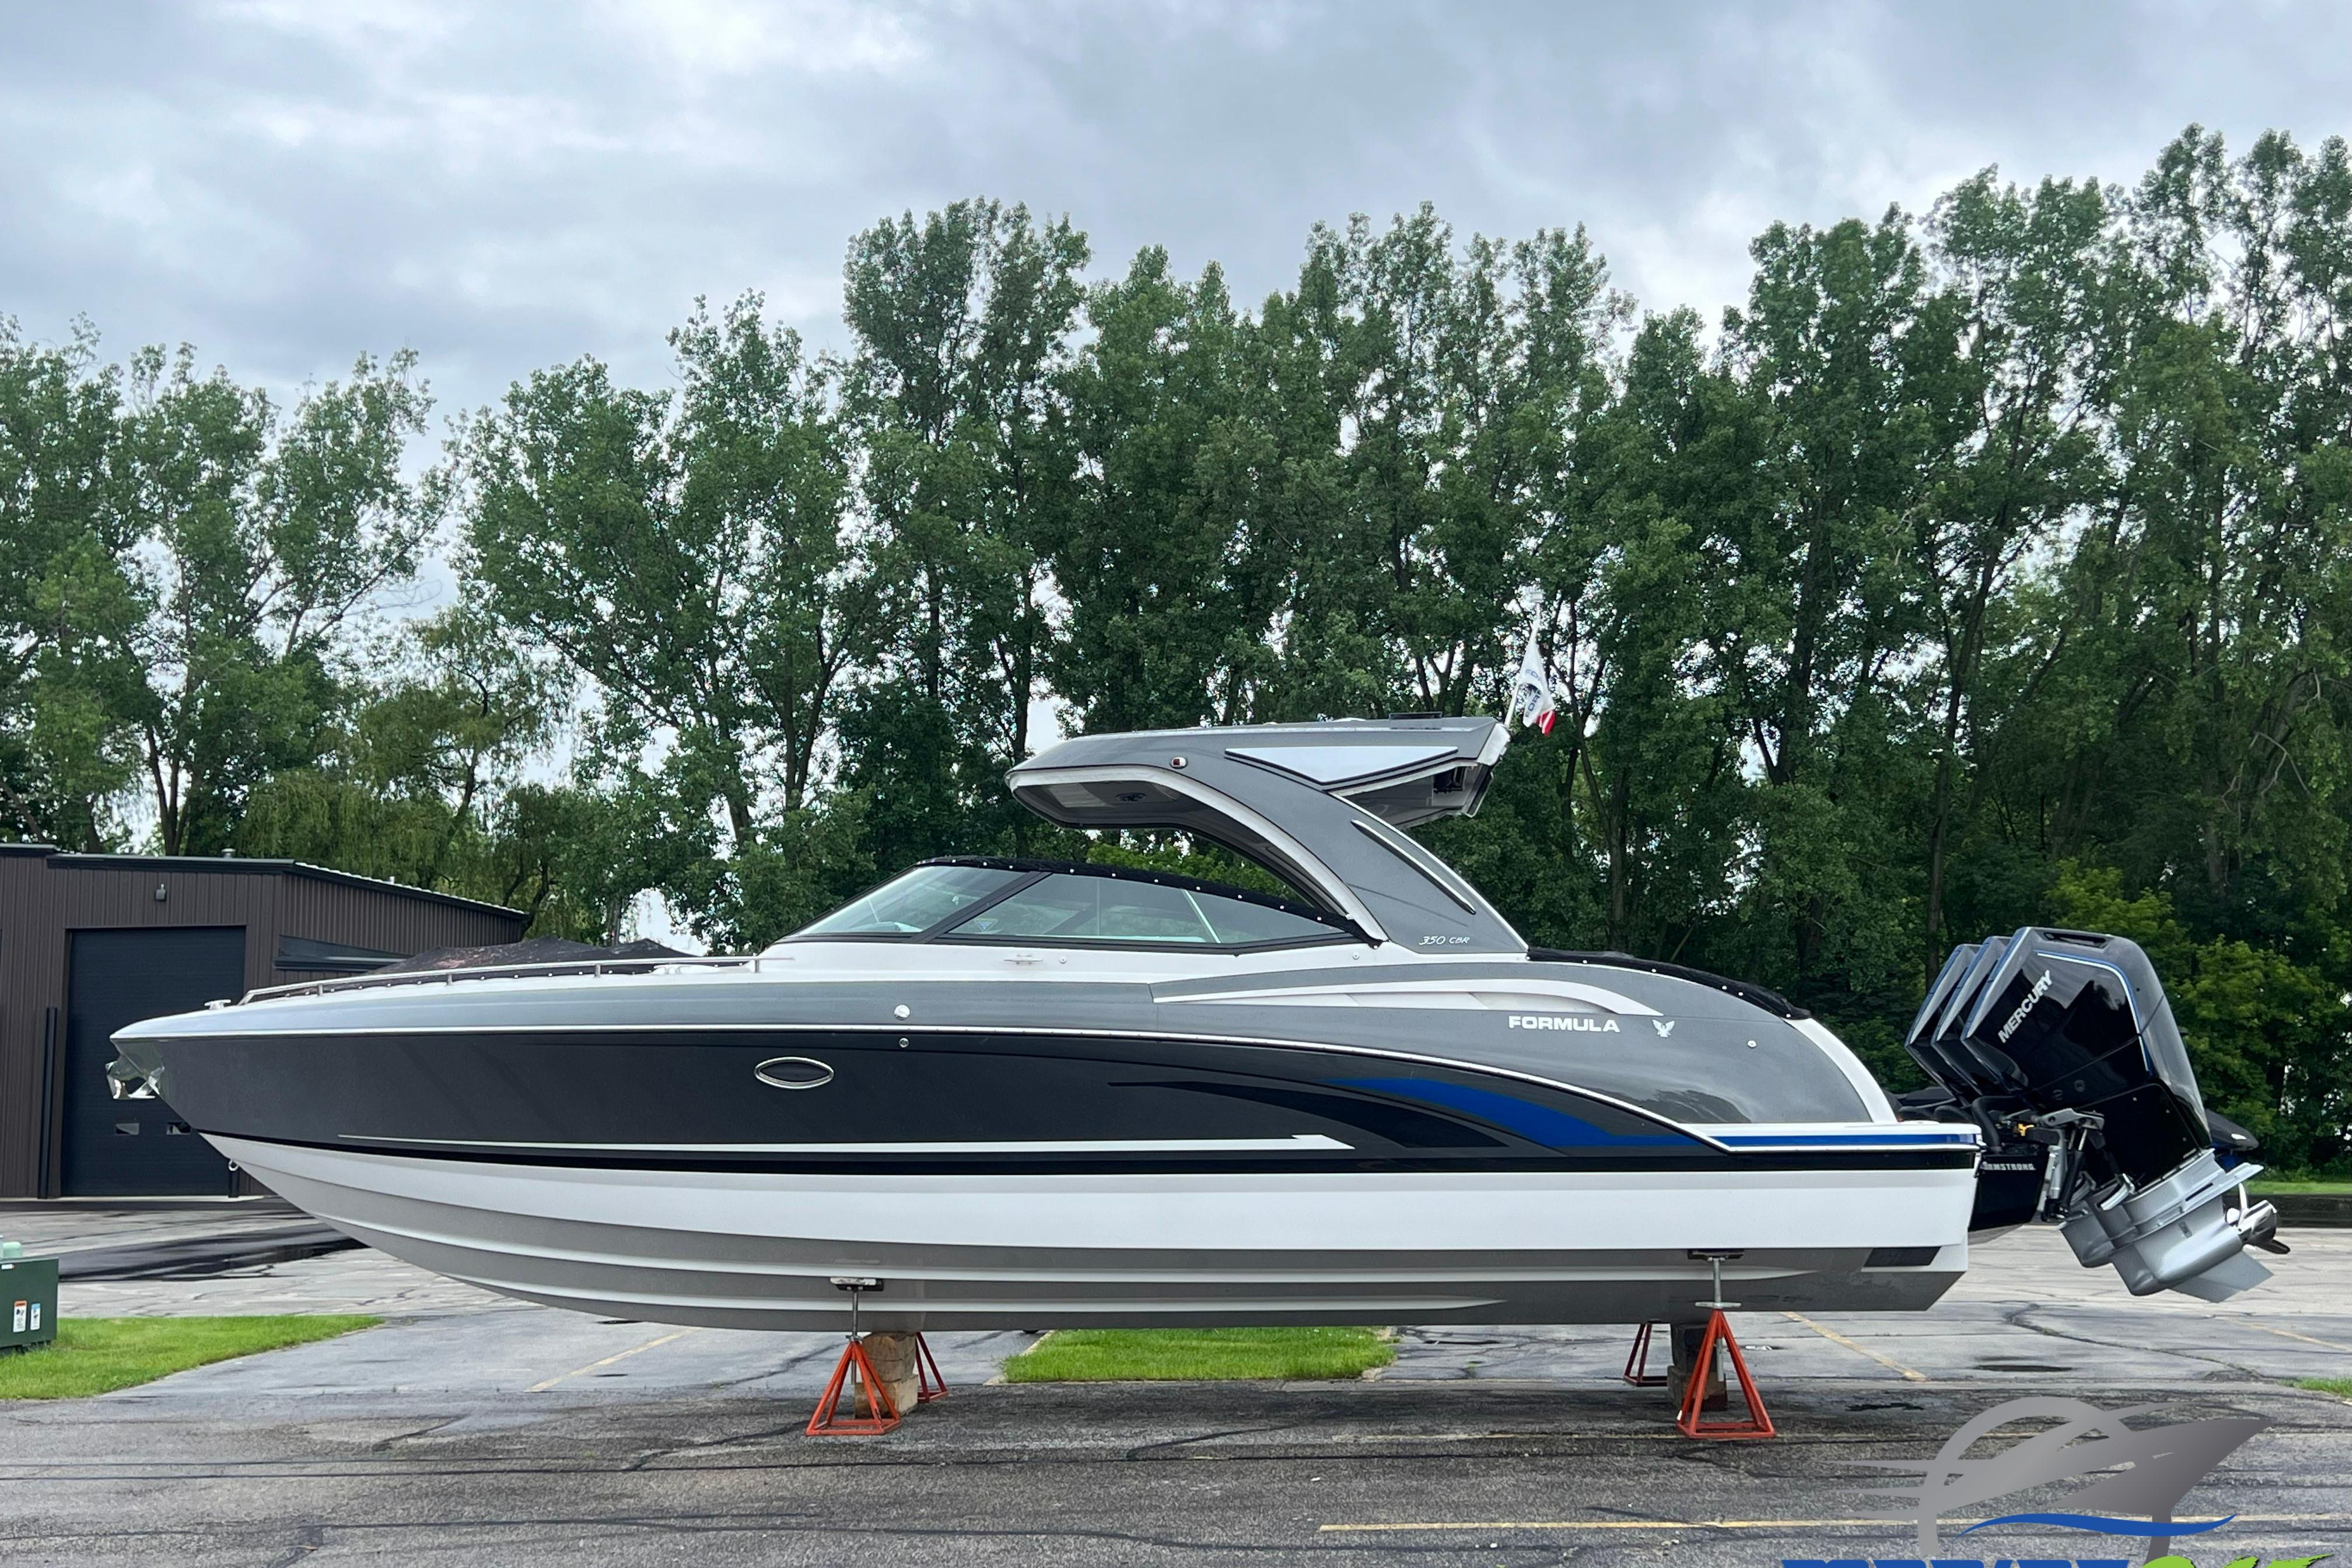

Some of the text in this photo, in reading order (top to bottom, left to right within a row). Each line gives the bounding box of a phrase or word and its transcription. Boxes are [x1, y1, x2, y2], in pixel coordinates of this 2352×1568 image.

[1419, 936, 1446, 946] 350
[1998, 970, 2052, 1043] MERCURY
[1508, 1016, 1620, 1032] FORMULA
